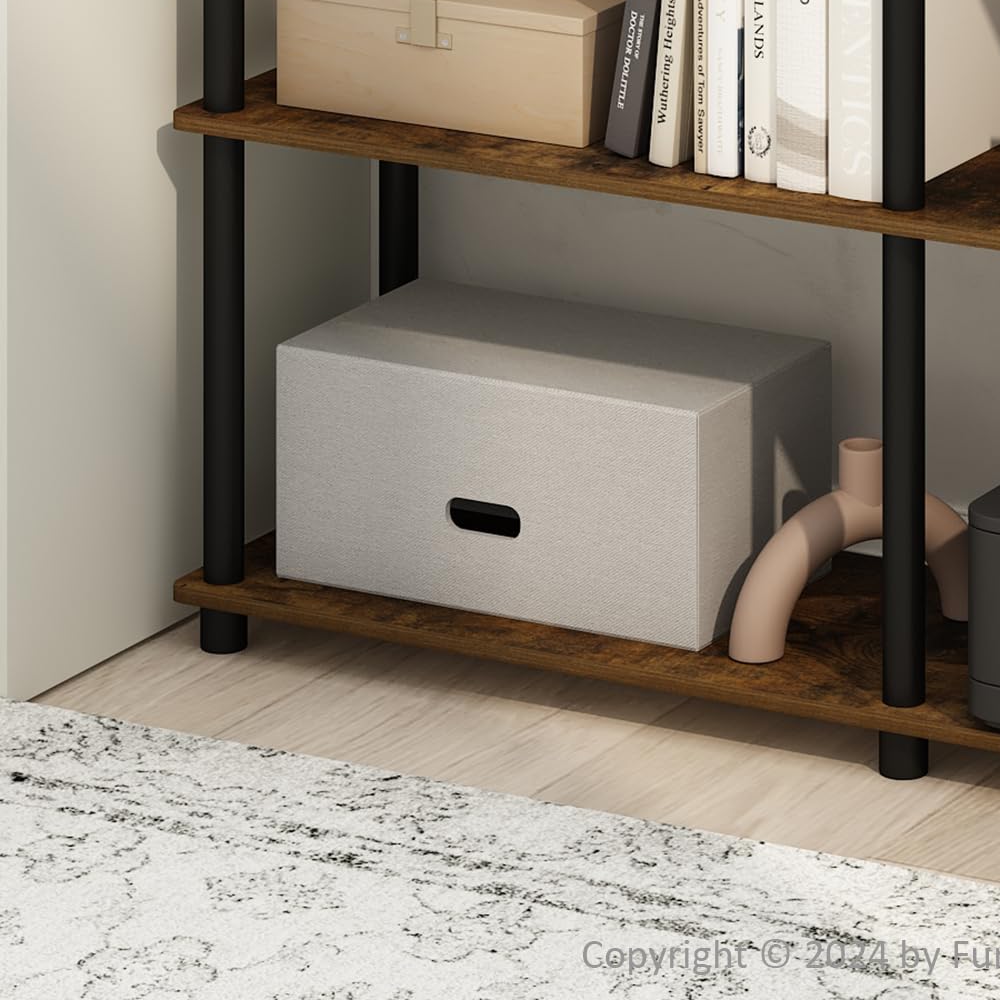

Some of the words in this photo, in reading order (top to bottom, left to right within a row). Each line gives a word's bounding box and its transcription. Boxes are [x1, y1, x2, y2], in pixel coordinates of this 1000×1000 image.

[625, 10, 638, 55] DOCTOR
[617, 56, 631, 110] DOLITTLE
[657, 54, 673, 124] Wuthering
[698, 64, 704, 76] of
[697, 109, 705, 153] Sawyer
